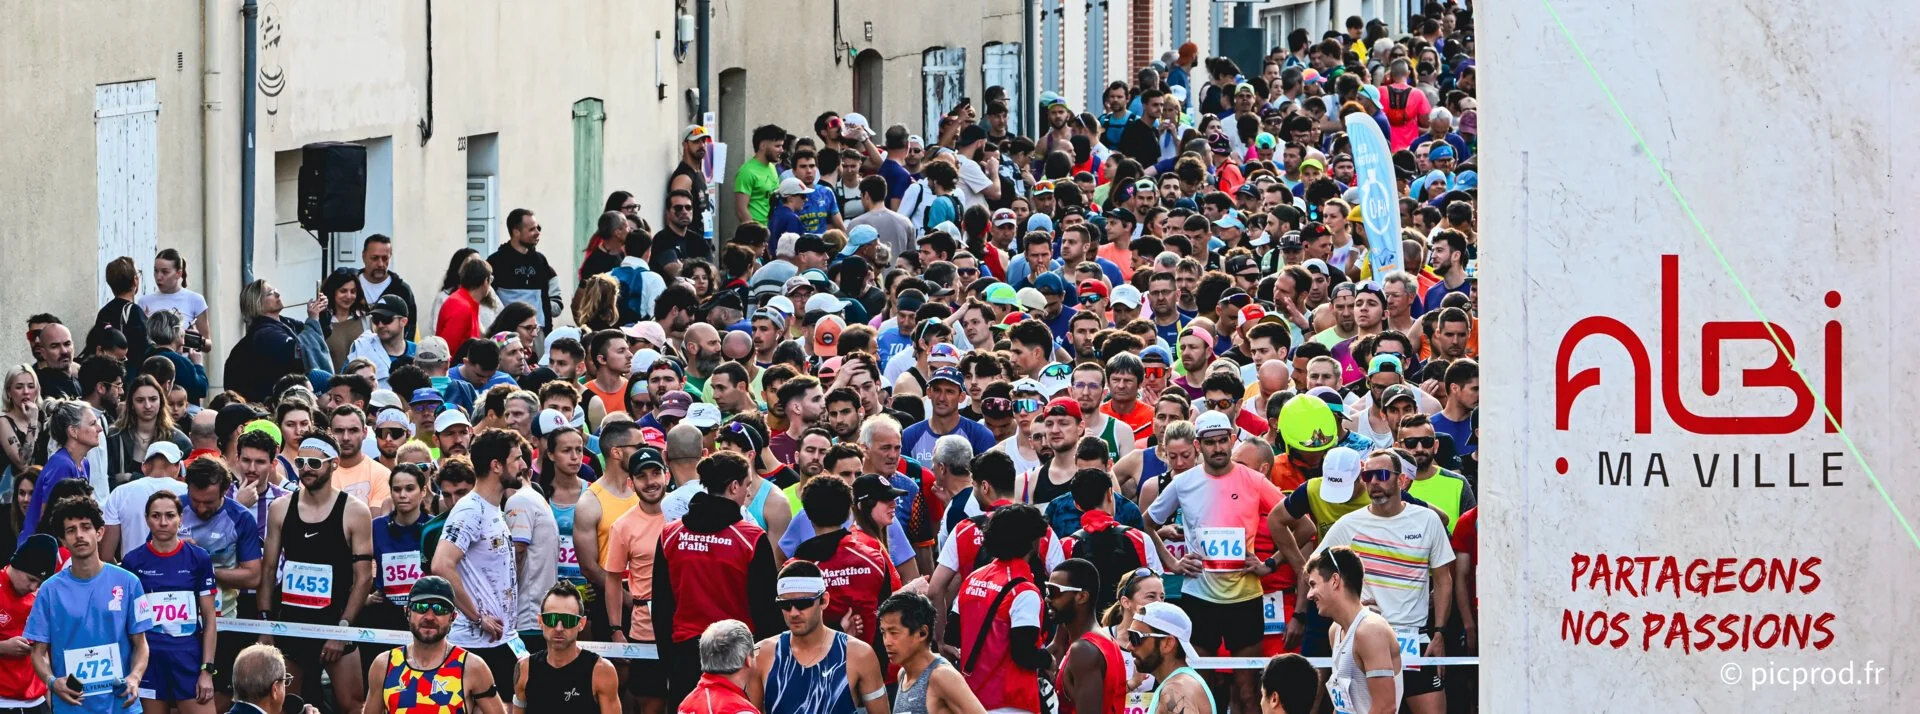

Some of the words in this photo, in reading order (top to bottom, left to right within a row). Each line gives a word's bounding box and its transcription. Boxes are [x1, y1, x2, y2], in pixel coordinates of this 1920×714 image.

[457, 136, 467, 152] 233
[1598, 451, 1670, 487] MA
[1693, 451, 1844, 487] VILLE
[678, 532, 733, 546] Marathon
[678, 541, 709, 552] d'albi
[1404, 533, 1422, 541] HOKA
[1200, 540, 1243, 557] 1616
[385, 563, 426, 582] 354
[821, 566, 872, 578] Marathon
[1571, 553, 1823, 598] PARTAGEONS
[286, 573, 330, 594] 1453
[152, 603, 189, 622] 704
[1561, 609, 1630, 649] NOS
[1642, 611, 1836, 654] PASSIONS
[75, 658, 114, 680] 472
